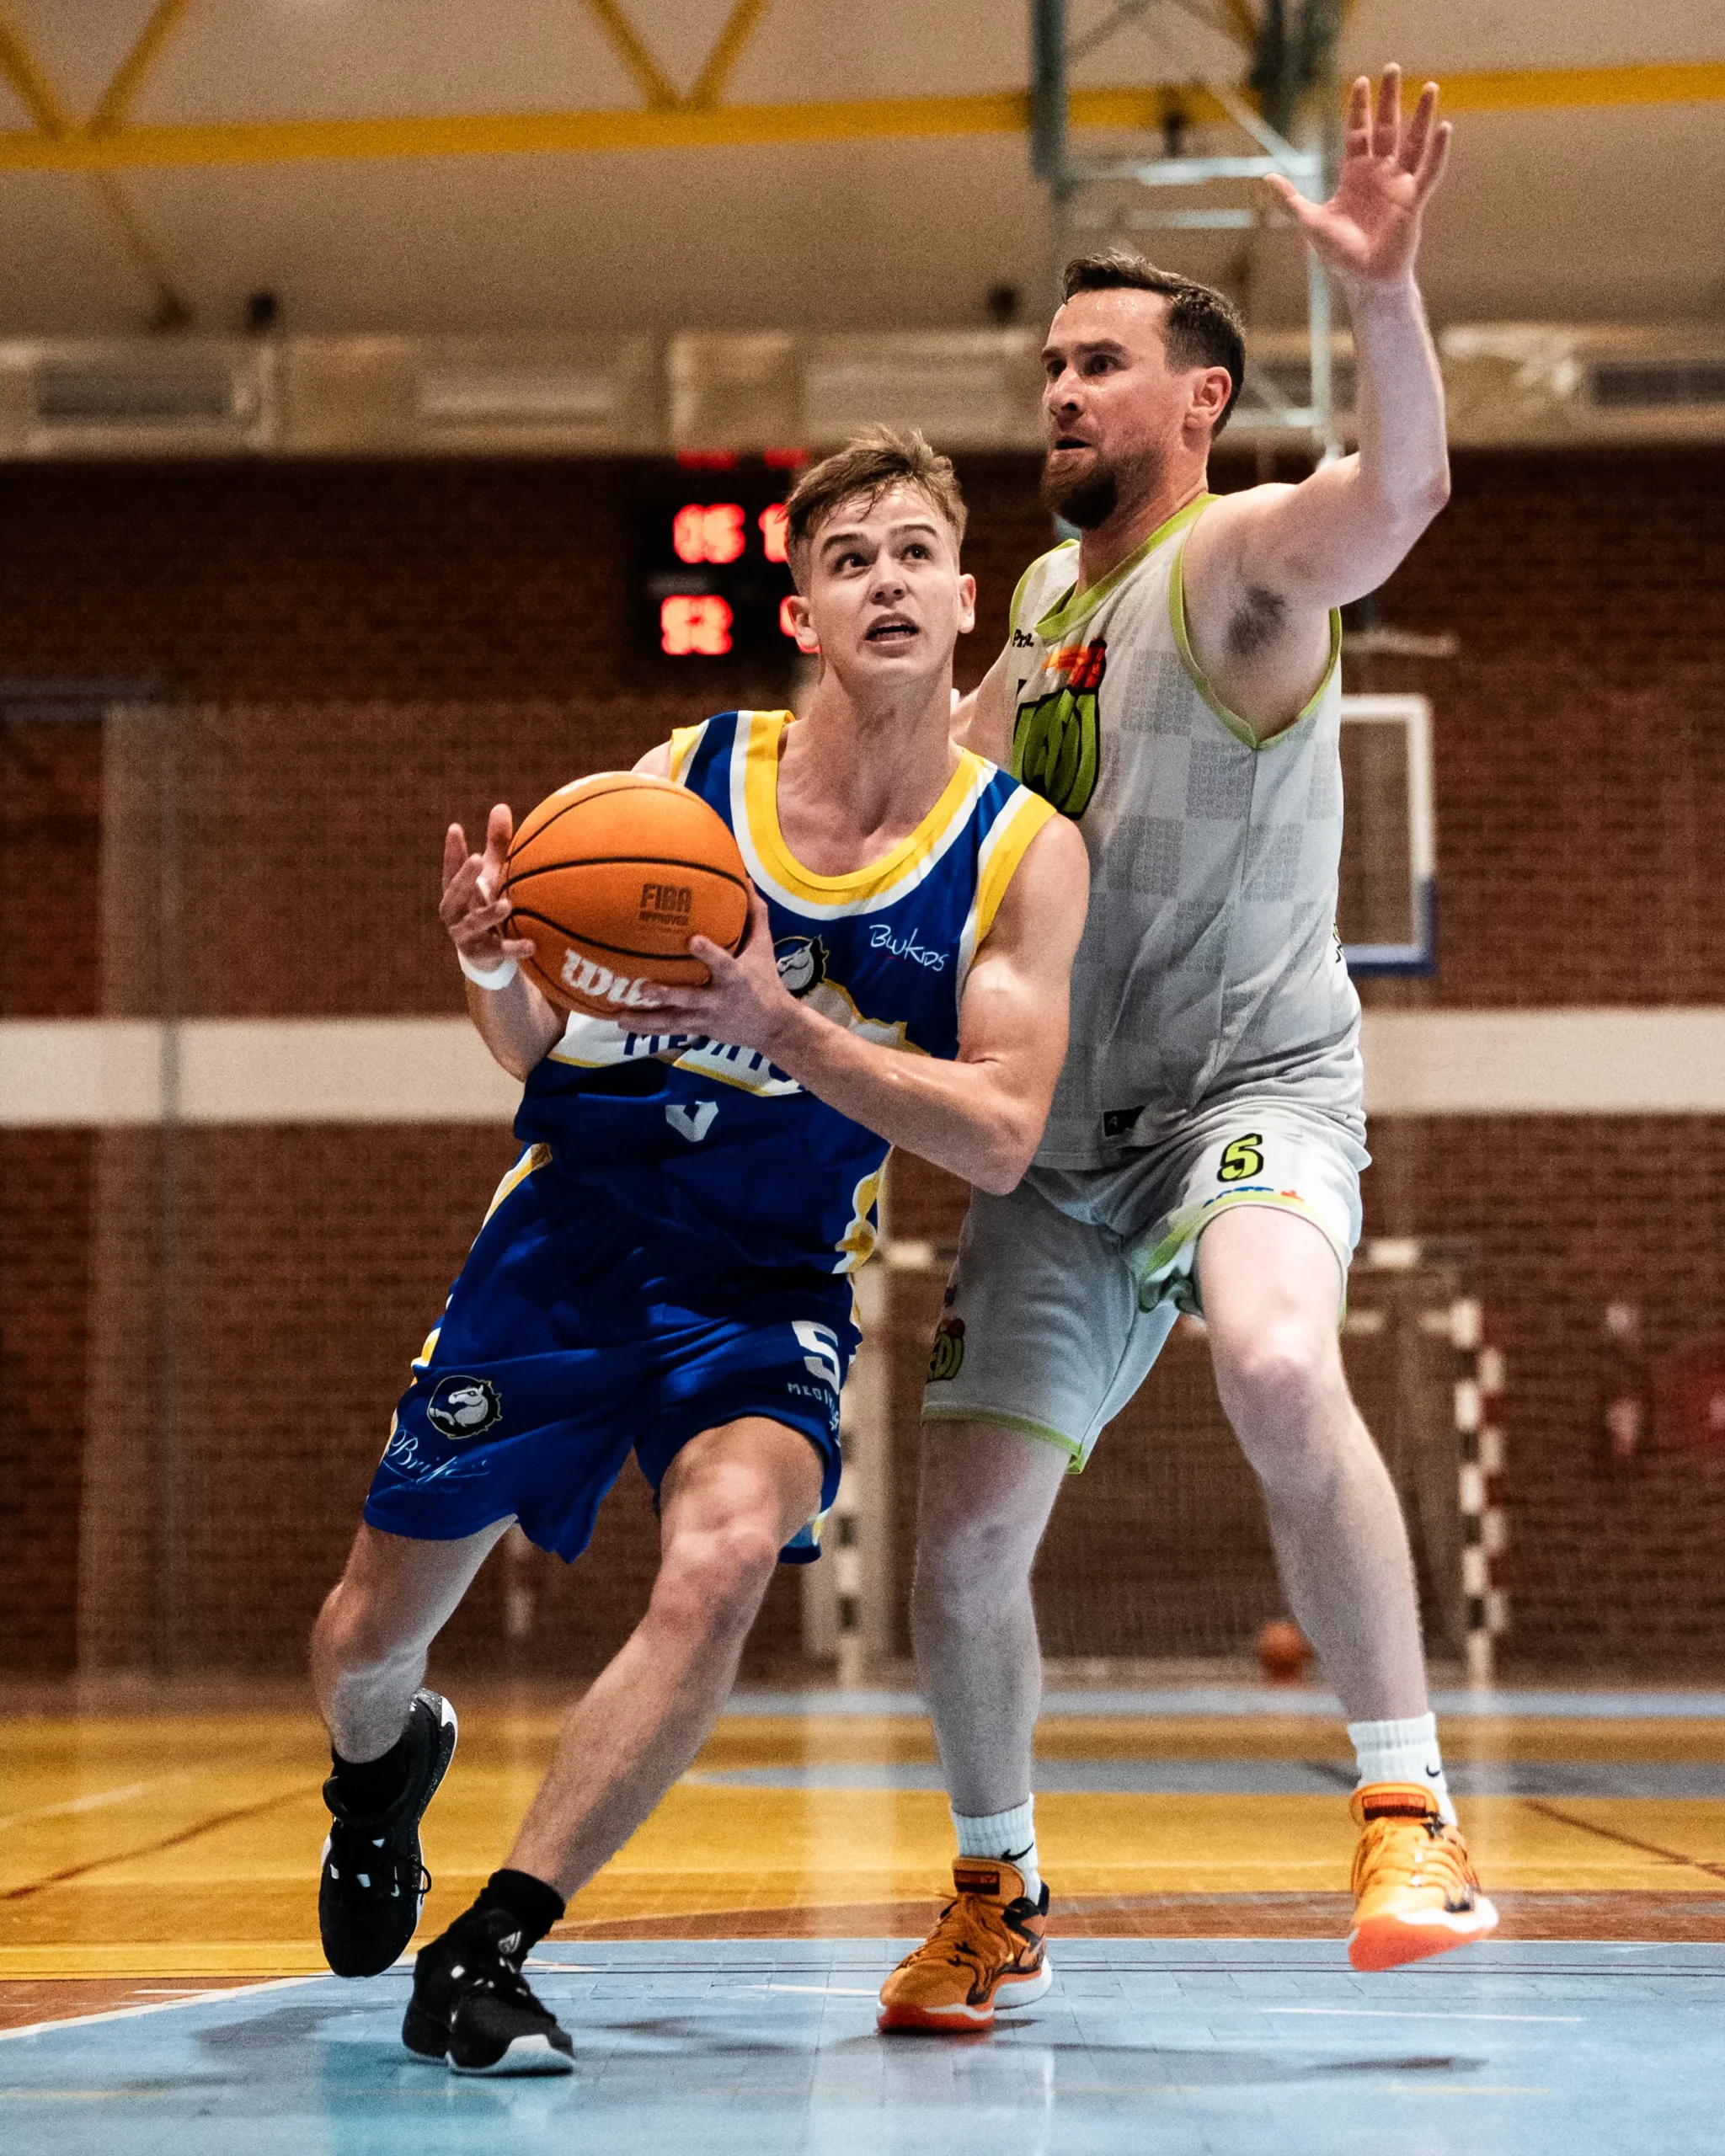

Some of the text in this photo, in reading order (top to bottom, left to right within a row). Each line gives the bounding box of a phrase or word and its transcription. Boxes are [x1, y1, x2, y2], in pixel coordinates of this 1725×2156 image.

[640, 883, 692, 913] FIBA
[1216, 1134, 1263, 1182] 5
[792, 1321, 841, 1396] 5
